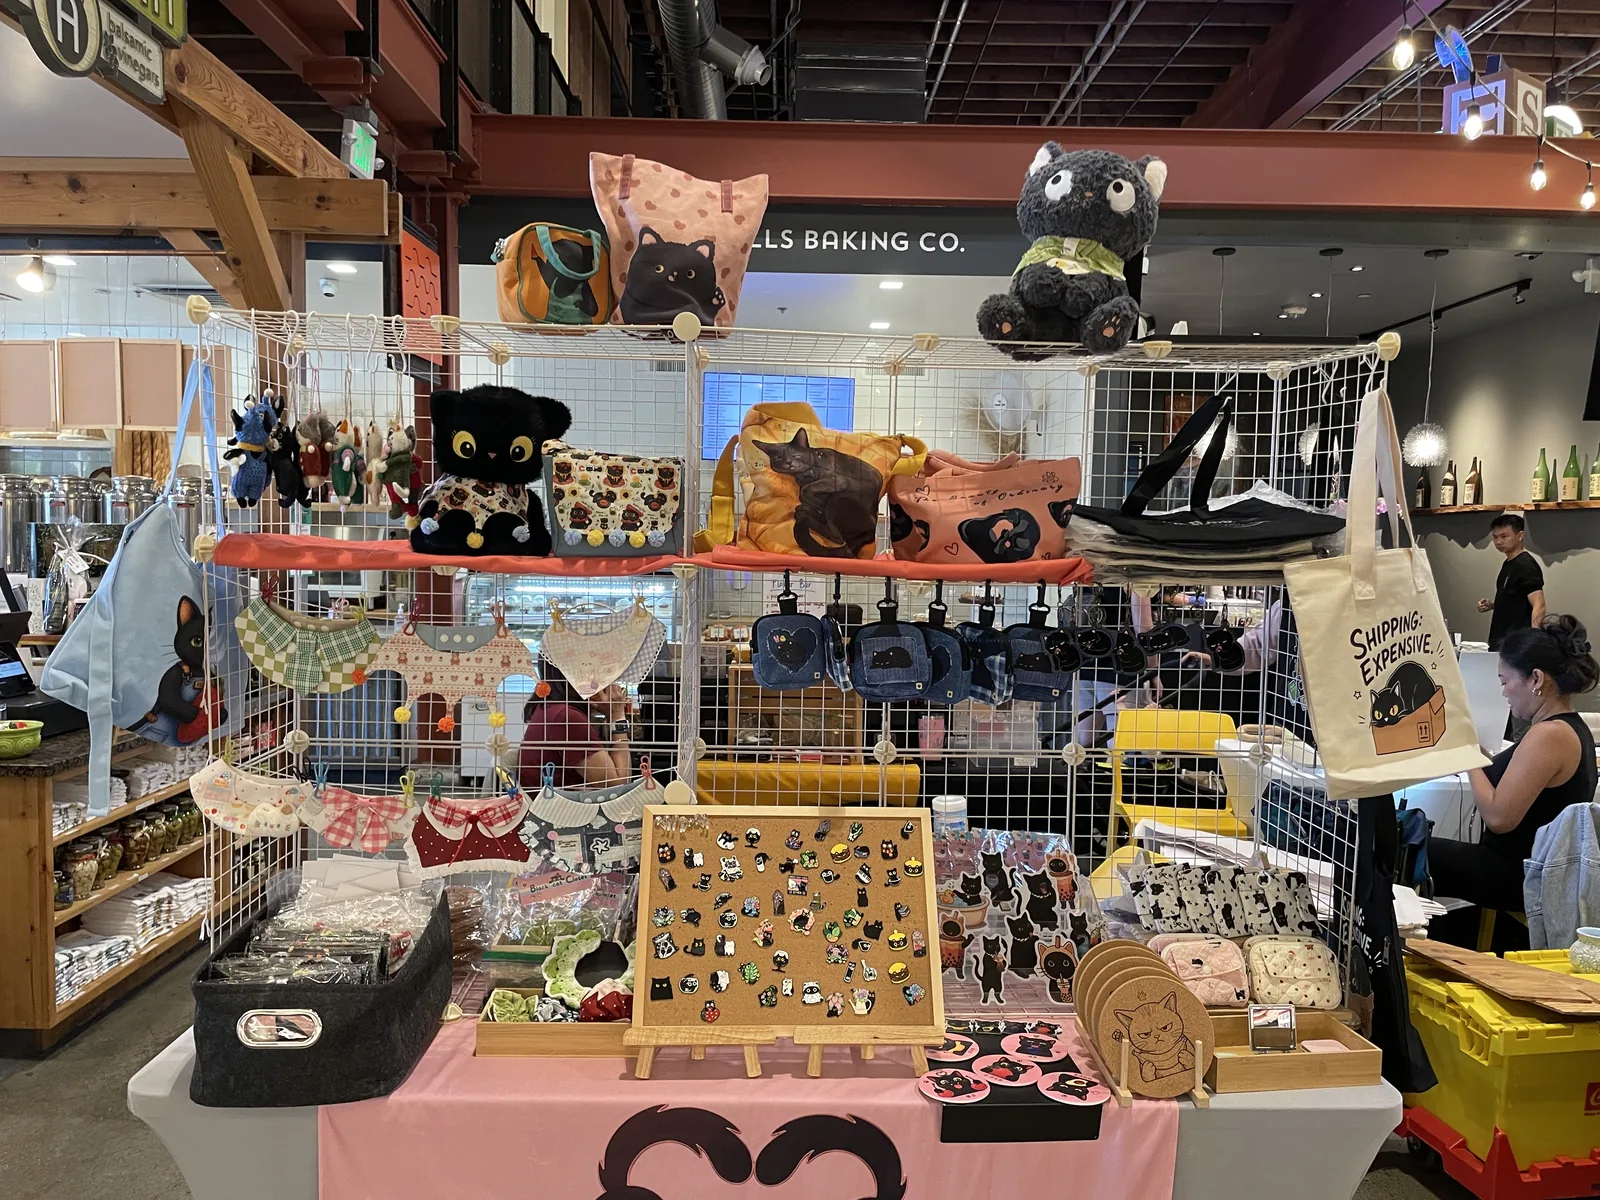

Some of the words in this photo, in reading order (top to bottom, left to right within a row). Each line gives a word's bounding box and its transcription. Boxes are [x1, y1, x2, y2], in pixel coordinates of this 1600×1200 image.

[106, 12, 153, 62] balsamic
[117, 46, 160, 88] vinegars
[804, 230, 909, 252] BAKING
[919, 231, 965, 252] CO.
[998, 483, 1064, 500] Ordinary
[1349, 610, 1423, 660] SHIPPING:
[1359, 633, 1434, 686] EXPENSIVE.
